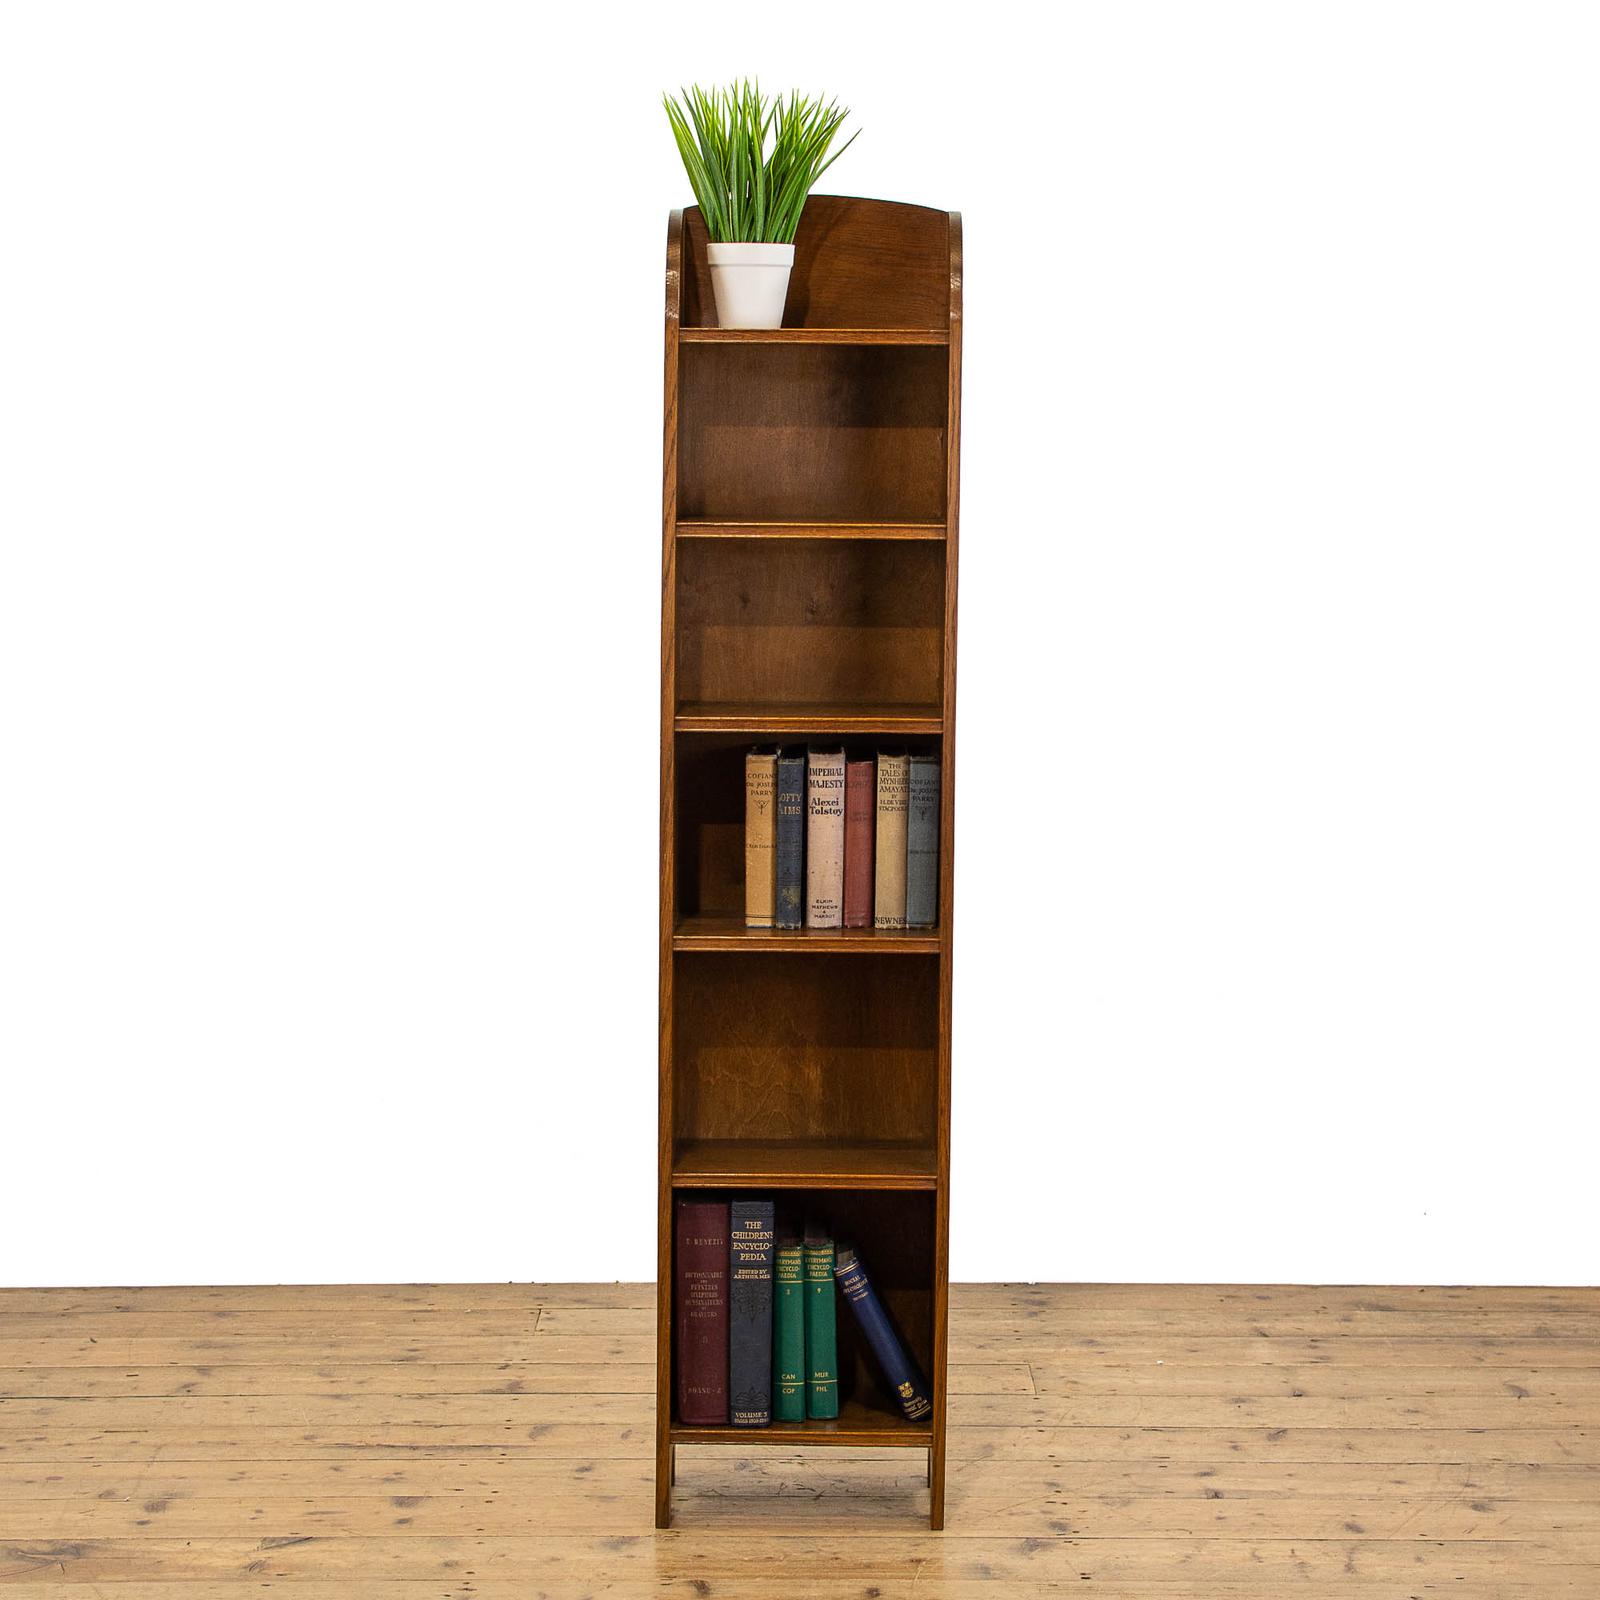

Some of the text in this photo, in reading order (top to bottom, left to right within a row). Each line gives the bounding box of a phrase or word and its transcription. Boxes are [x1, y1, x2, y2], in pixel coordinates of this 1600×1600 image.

[809, 767, 843, 777] IMPERIAL
[880, 769, 900, 777] TALES
[809, 780, 844, 789] MAJESTY
[779, 793, 802, 802] OFTY
[811, 798, 839, 806] Alexei
[809, 807, 843, 816] Tolstoy
[744, 1221, 762, 1229] THE
[733, 1243, 773, 1251] ENCYCLO-
[740, 1253, 767, 1261] PEDIA
[735, 1411, 762, 1419] VOLUME
